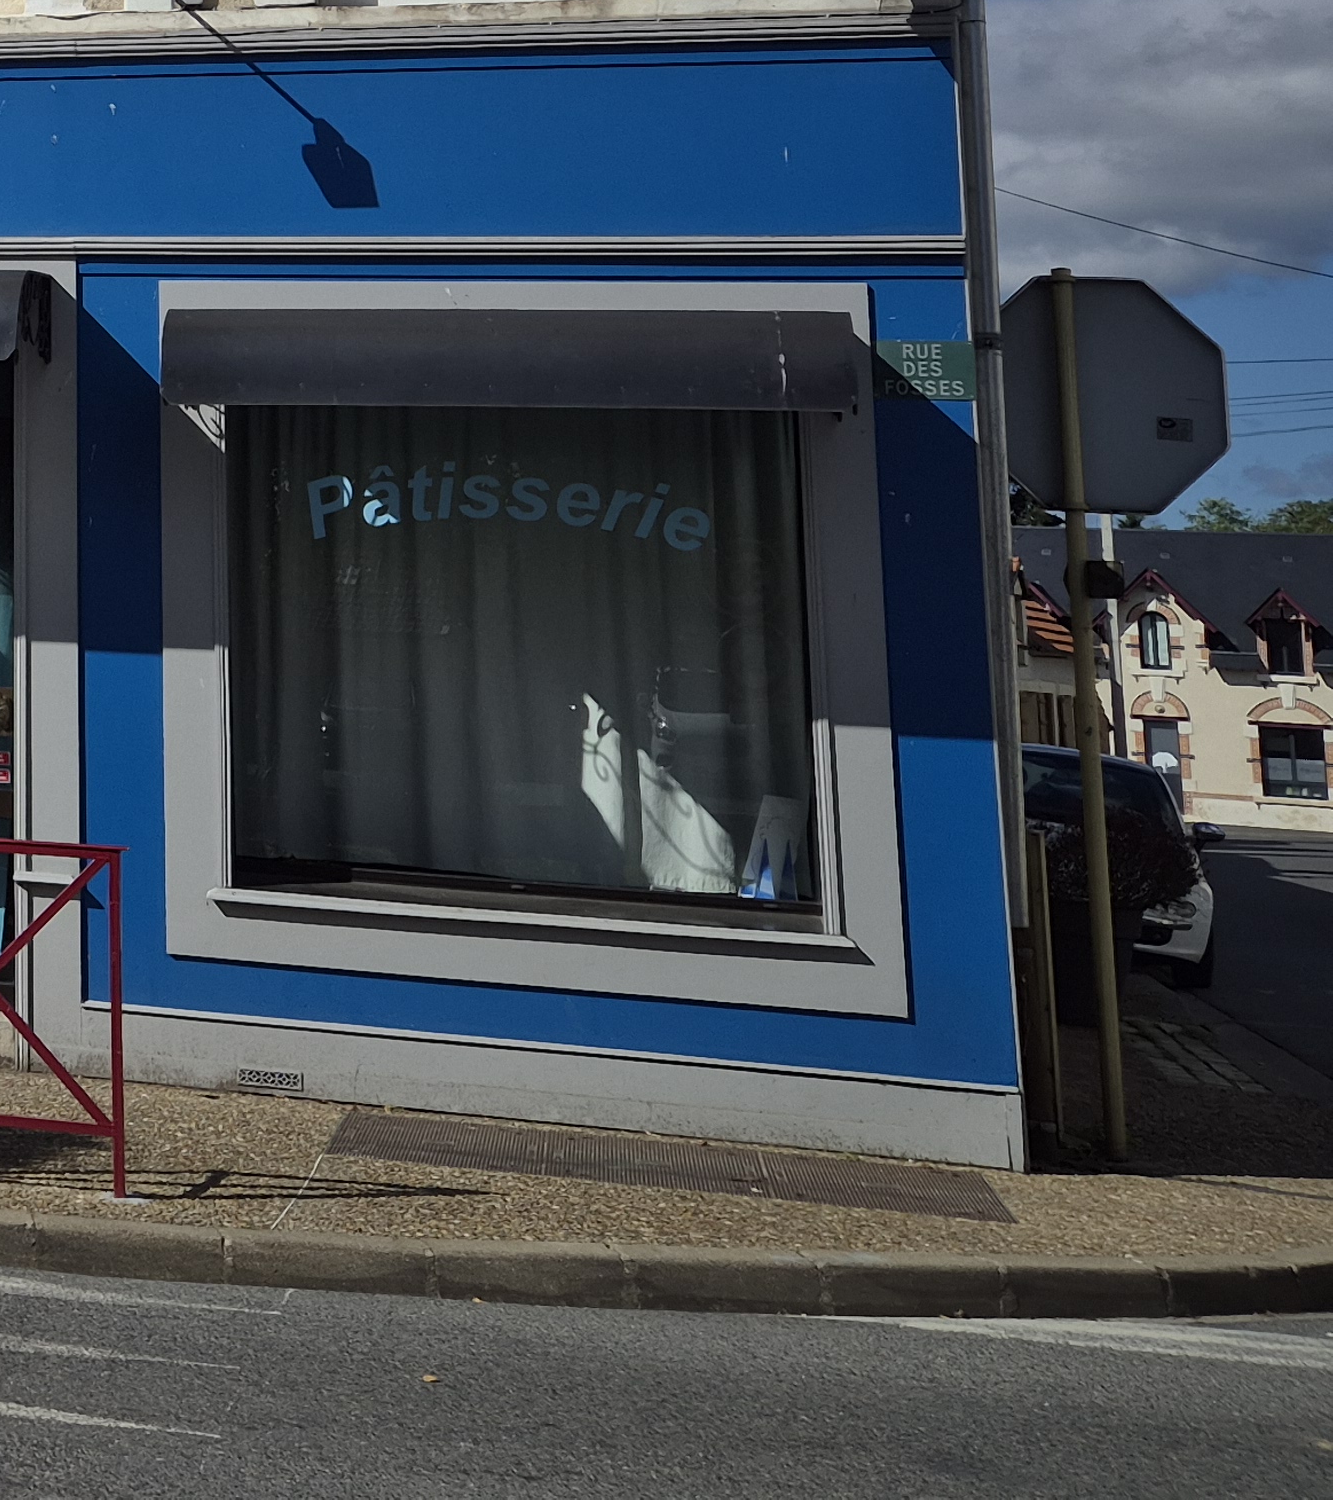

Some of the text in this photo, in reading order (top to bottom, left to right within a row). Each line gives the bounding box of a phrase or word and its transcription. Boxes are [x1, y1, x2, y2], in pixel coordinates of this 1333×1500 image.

[902, 343, 943, 360] RUE
[903, 361, 943, 377] DES
[884, 380, 965, 397] FOSSES
[306, 460, 712, 552] Pâtisserie
